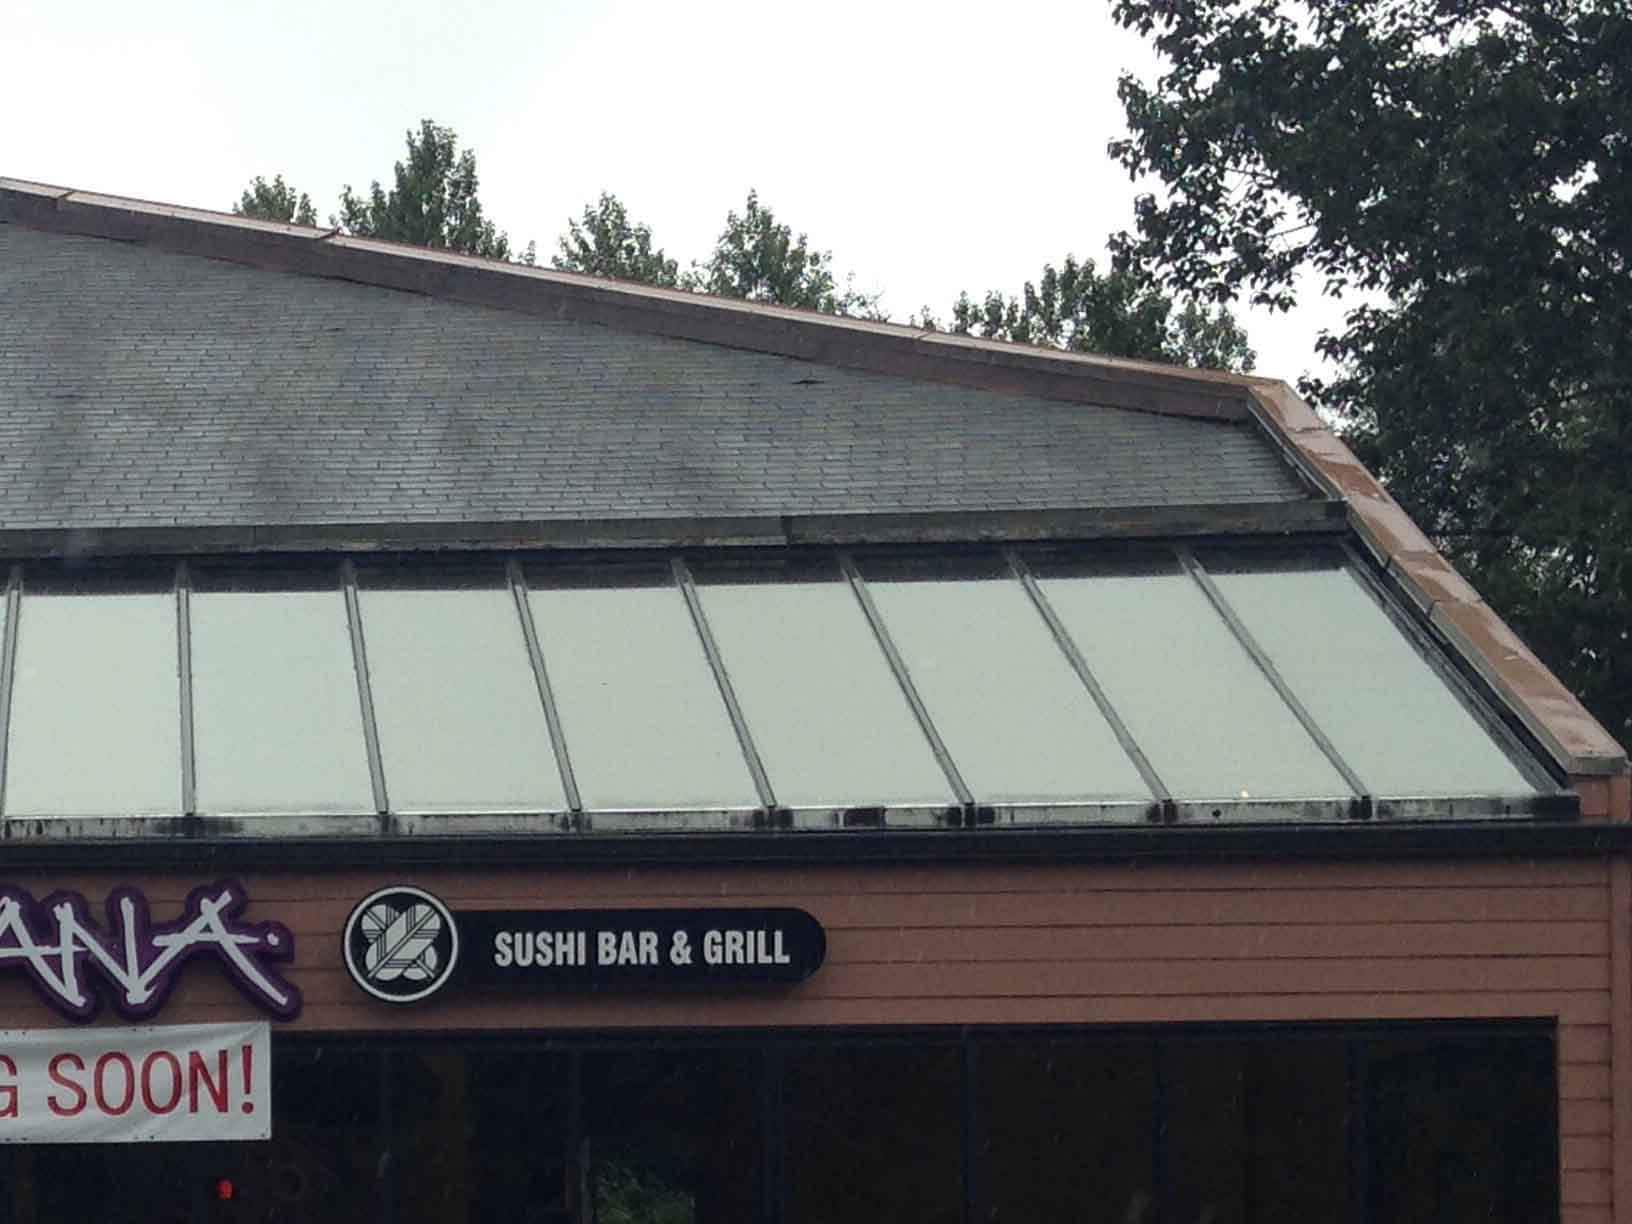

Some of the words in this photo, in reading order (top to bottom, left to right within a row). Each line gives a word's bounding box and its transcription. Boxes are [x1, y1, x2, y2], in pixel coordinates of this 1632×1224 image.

[494, 931, 587, 967] SUSHI
[597, 930, 659, 966] BAR
[670, 930, 693, 965] &
[703, 929, 791, 965] GRILL
[47, 1045, 255, 1116] SOON!
